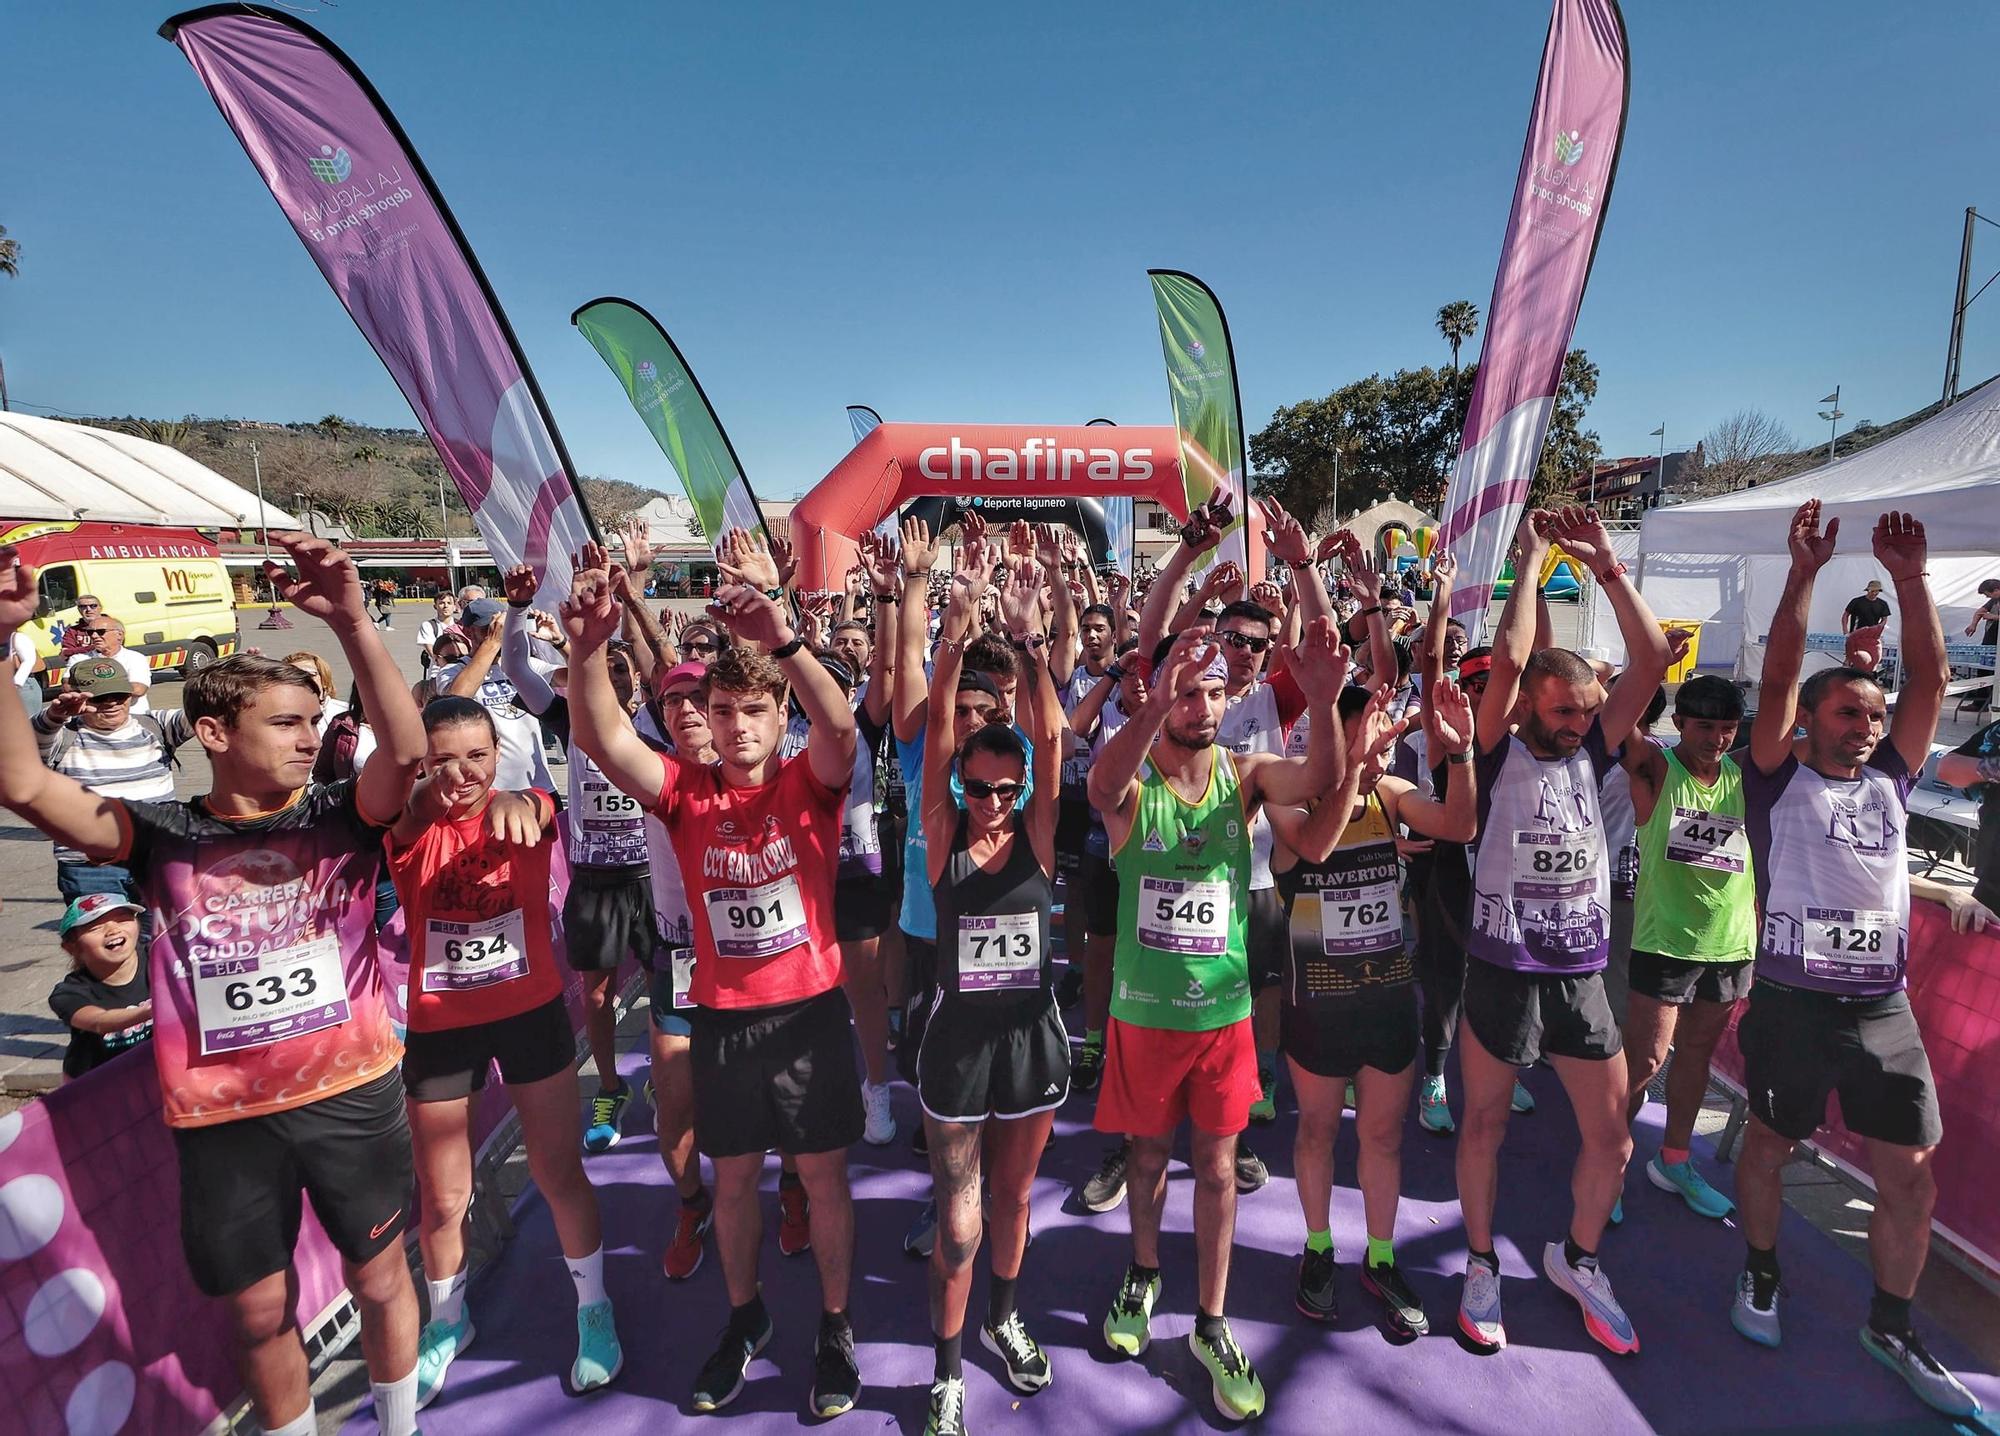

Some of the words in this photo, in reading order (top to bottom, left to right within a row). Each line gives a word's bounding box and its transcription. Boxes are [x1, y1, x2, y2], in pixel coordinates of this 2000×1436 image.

[918, 437, 1154, 481] chafiras
[984, 498, 1022, 510] deporte
[1023, 497, 1066, 510] lagunero
[90, 545, 210, 559] AMBULANCIA
[593, 795, 636, 812] 155
[1530, 833, 1551, 844] ELA
[1684, 823, 1733, 847] 447
[703, 845, 727, 878] CCT
[727, 850, 768, 884] SANTA
[762, 835, 798, 875] CRUZ
[1533, 848, 1588, 873] 826
[205, 878, 311, 912] CARRERA
[721, 890, 740, 901] ELA
[1155, 881, 1175, 892] ELA
[1334, 892, 1353, 901] ELA
[728, 899, 784, 930] 901
[1155, 898, 1215, 924] 546
[1338, 901, 1390, 928] 762
[1819, 910, 1843, 921] ELA
[966, 919, 987, 929] ELA
[445, 931, 507, 963] 634
[970, 933, 1032, 959] 713
[1826, 926, 1882, 953] 128
[215, 961, 247, 977] ELA
[225, 967, 318, 1011] 633
[1171, 996, 1217, 1009] TENERIFE
